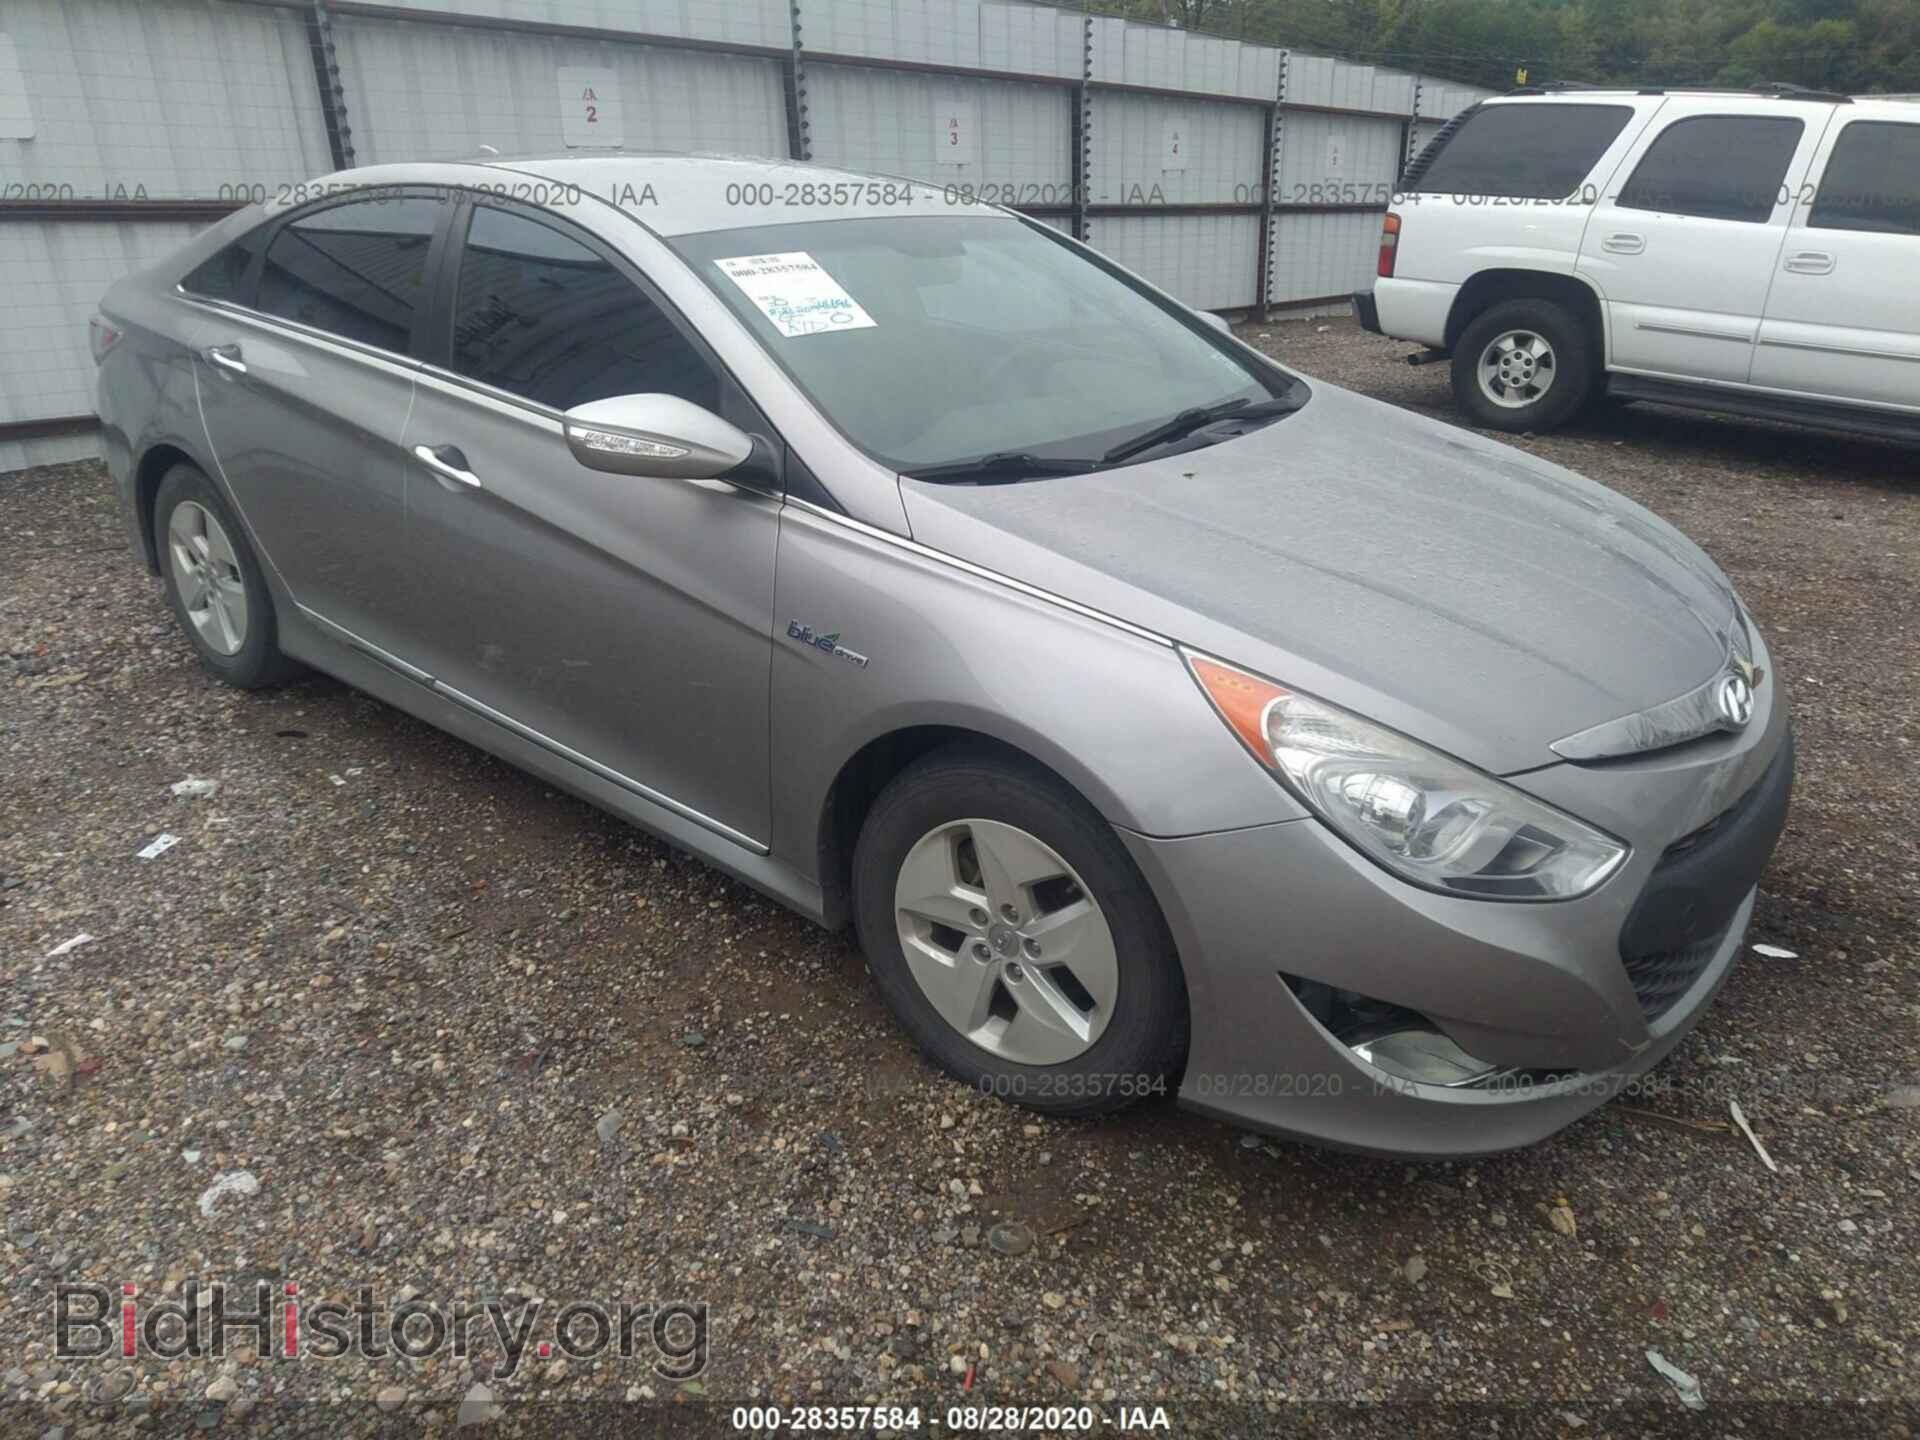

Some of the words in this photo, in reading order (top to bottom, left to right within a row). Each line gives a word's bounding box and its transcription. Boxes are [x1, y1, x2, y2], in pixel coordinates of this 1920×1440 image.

[585, 105, 599, 123] 2
[950, 131, 959, 146] 3
[786, 618, 832, 654] blue
